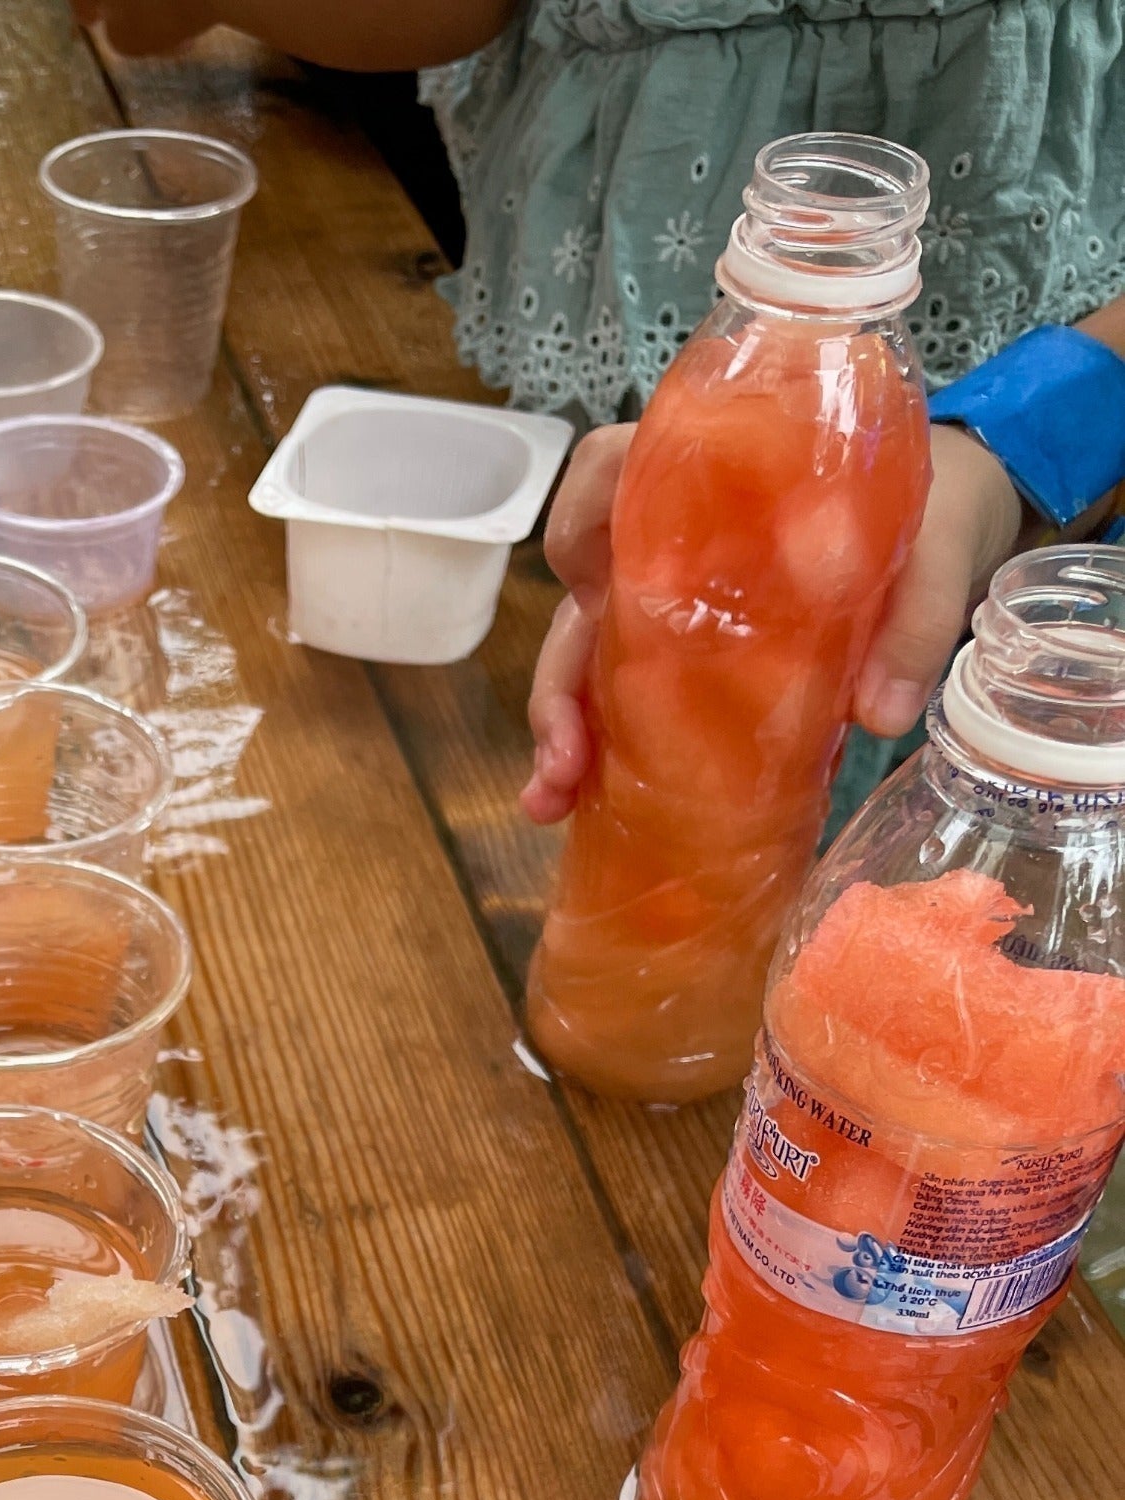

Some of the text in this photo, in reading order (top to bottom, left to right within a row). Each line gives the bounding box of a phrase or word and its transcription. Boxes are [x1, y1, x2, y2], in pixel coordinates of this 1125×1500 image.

[810, 1098, 873, 1148] WATER
[965, 1190, 986, 1198] qua
[889, 1263, 909, 1275] Sản
[909, 1267, 935, 1279] xuất
[935, 1270, 961, 1279] theo
[962, 1269, 992, 1280] QCVN
[913, 1259, 936, 1270] tiêu
[936, 1262, 962, 1271] chất
[883, 1280, 907, 1293] Thể
[935, 1288, 962, 1299] thực
[896, 1308, 931, 1319] 330ml
